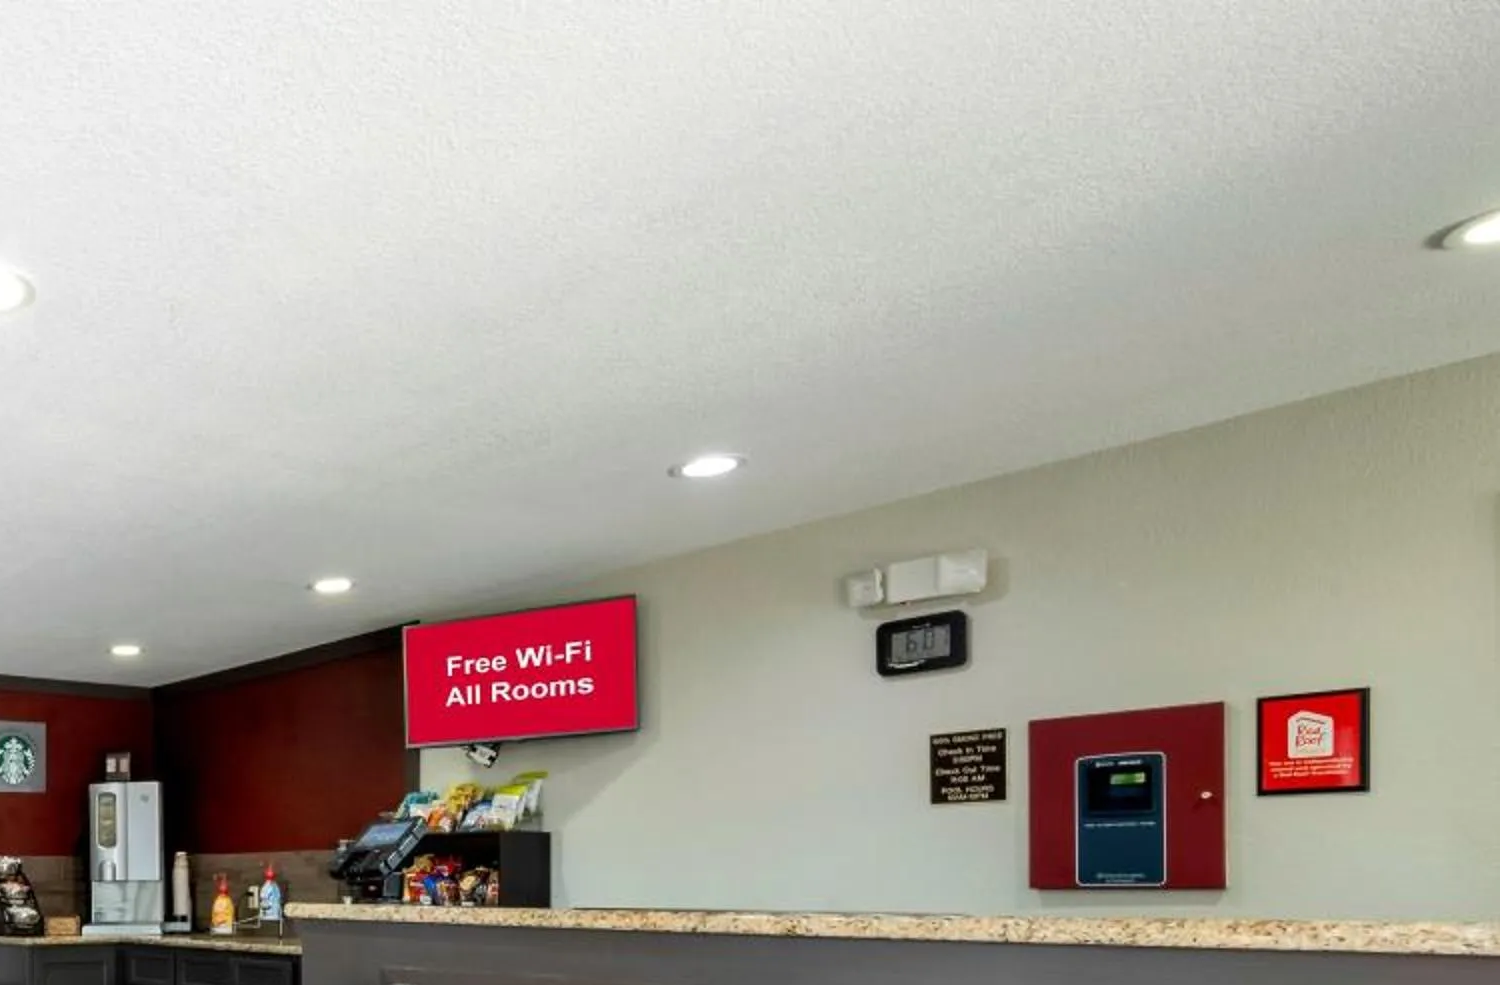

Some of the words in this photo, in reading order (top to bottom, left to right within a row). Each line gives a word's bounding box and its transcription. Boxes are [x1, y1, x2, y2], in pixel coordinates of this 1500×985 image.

[446, 655, 507, 677] Free
[515, 640, 592, 669] Wi-Fi
[445, 684, 481, 707] All
[491, 676, 594, 703] Rooms
[1297, 724, 1321, 735] Red
[1295, 732, 1324, 748] Roof
[977, 745, 997, 753] Time
[980, 765, 1001, 773] Time
